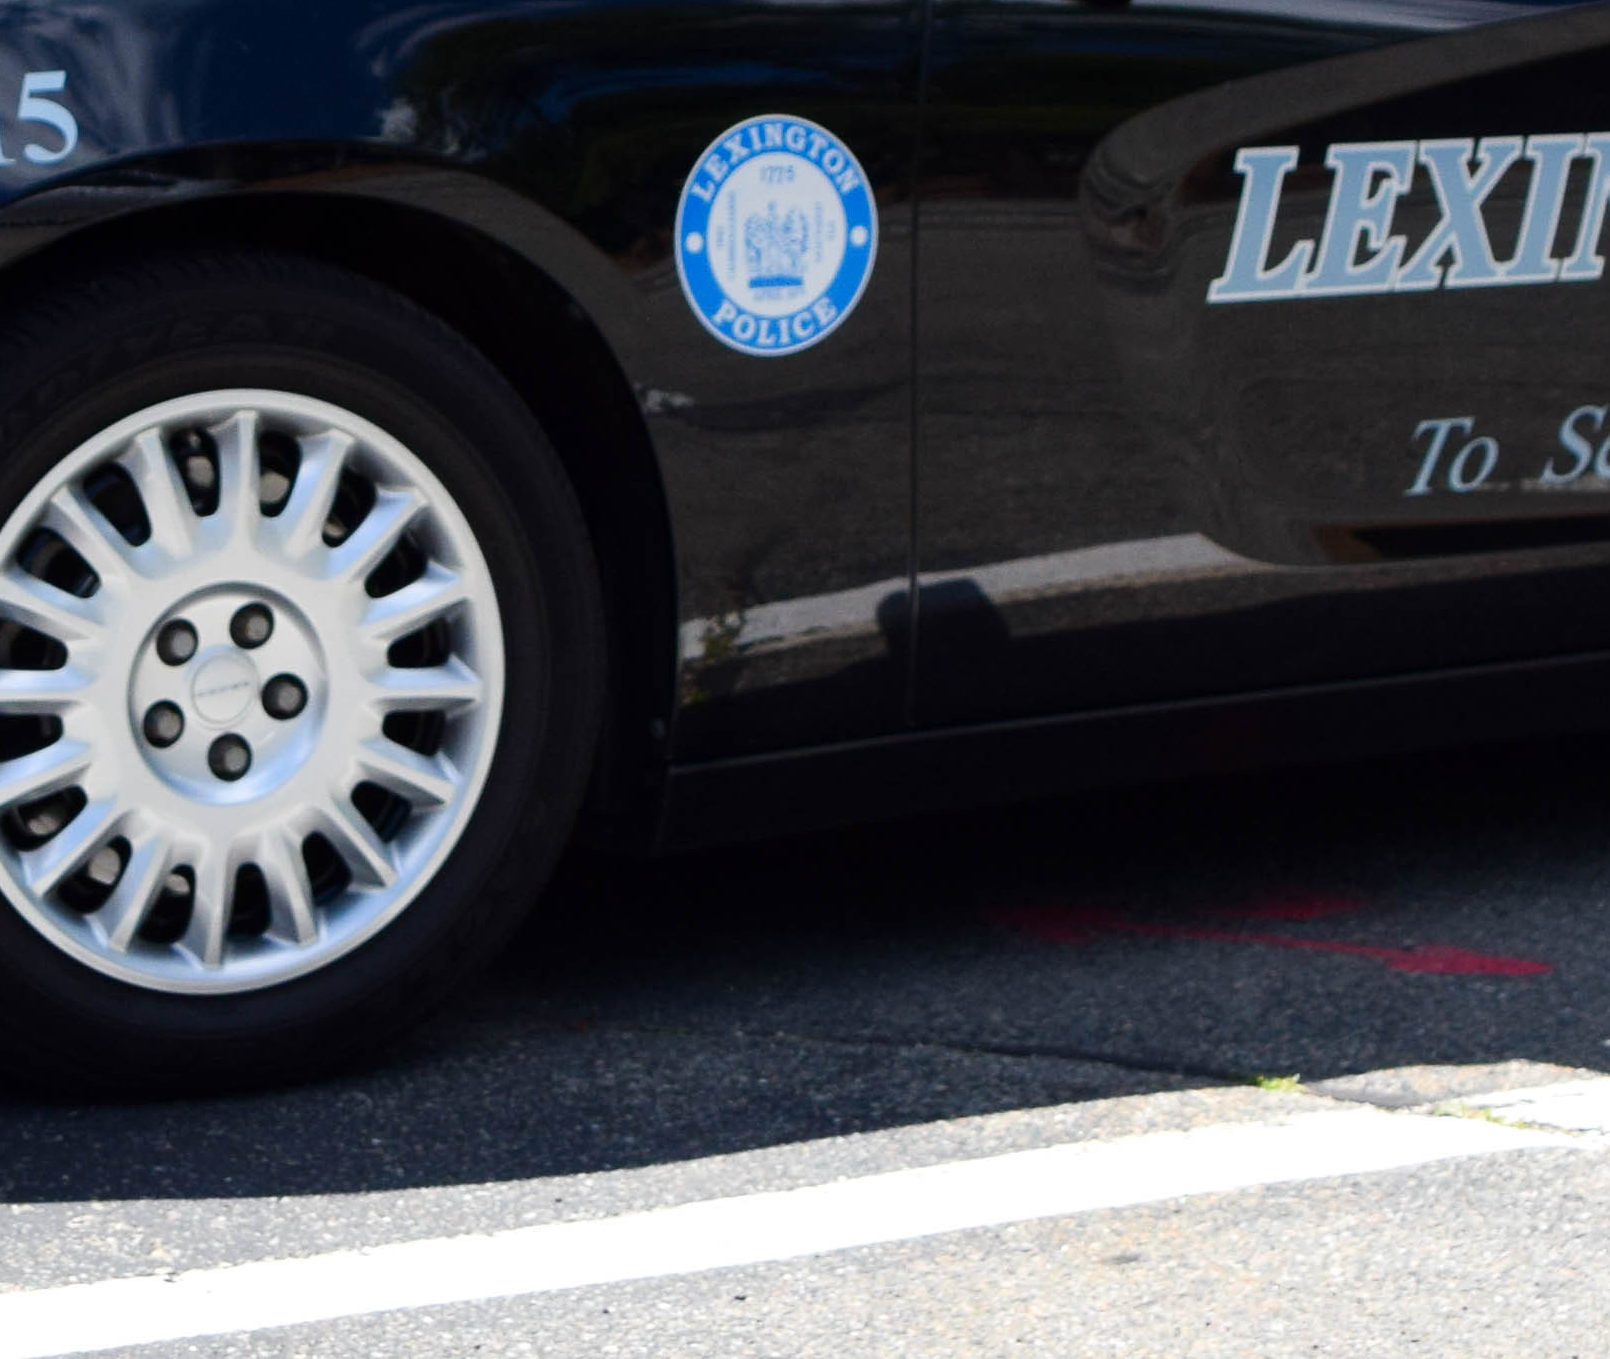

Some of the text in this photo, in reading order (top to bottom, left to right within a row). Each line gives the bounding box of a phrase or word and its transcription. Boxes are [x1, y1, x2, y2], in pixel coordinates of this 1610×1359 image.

[691, 122, 860, 200] LEXINGTON
[712, 296, 837, 346] POLICE
[1403, 416, 1499, 497] To
